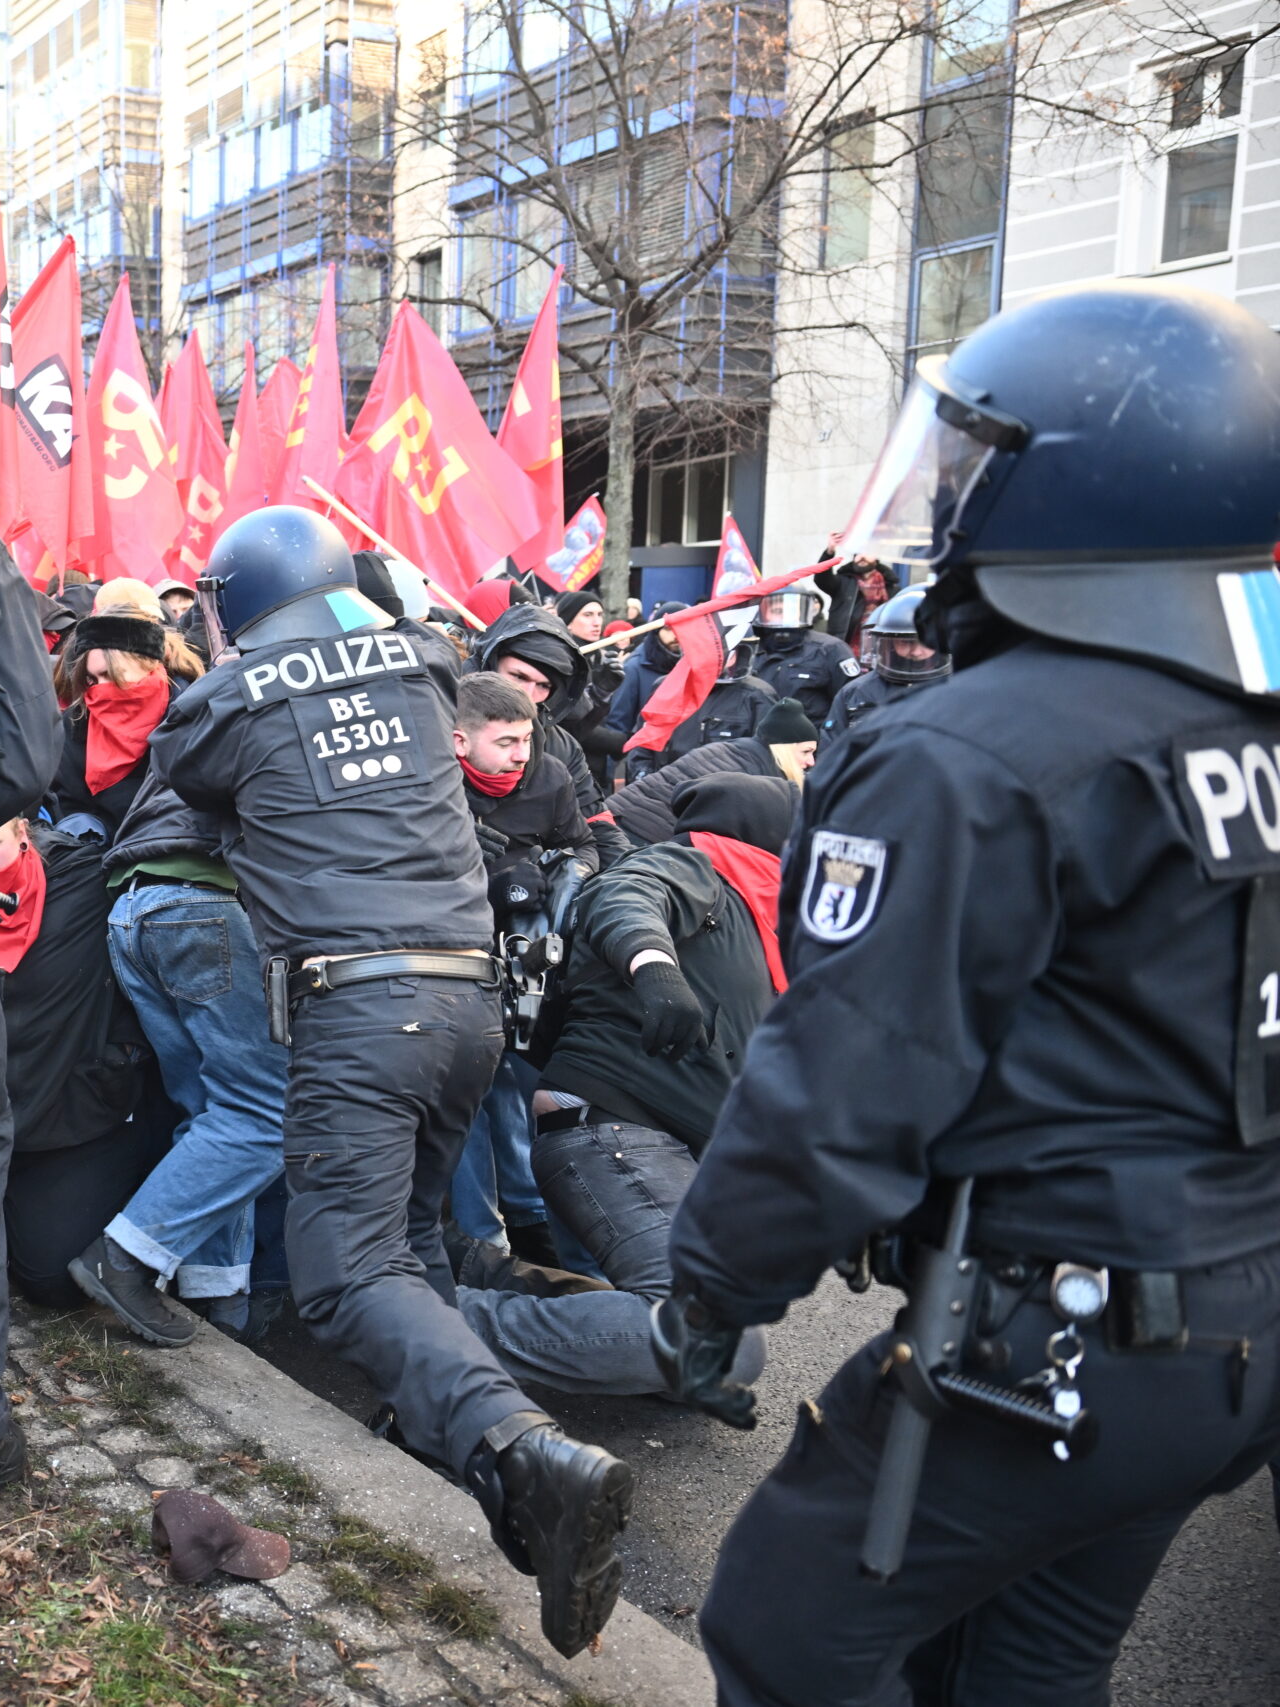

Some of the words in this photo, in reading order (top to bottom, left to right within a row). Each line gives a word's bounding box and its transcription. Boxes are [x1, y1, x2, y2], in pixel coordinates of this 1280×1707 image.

[242, 633, 420, 703] POLIZEI
[327, 692, 376, 723] BE
[312, 716, 411, 760] 15301
